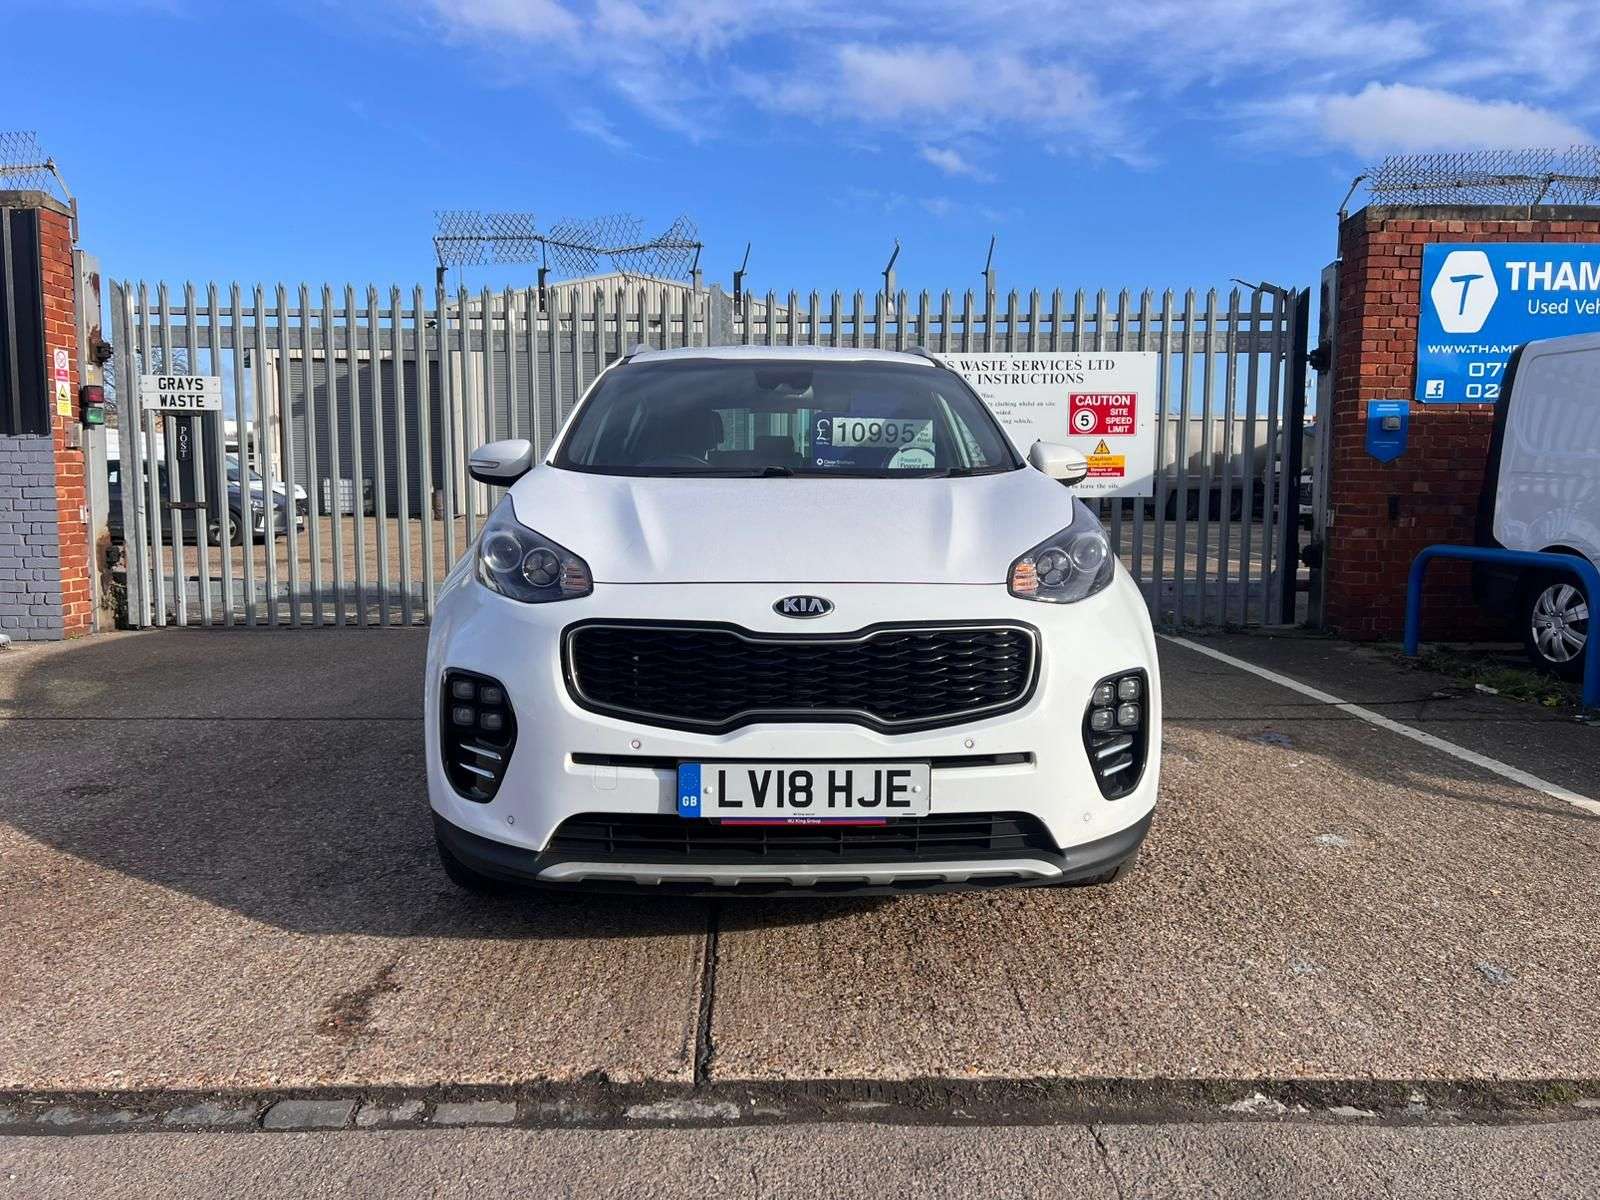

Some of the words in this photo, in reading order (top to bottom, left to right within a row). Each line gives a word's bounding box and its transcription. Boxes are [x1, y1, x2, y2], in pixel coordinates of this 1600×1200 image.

[1528, 298, 1568, 314] Used
[960, 360, 1008, 371] WASTE
[1012, 360, 1082, 371] SERVICES
[1088, 360, 1115, 371] LTD
[1469, 362, 1508, 377] 07
[158, 377, 204, 391] GRAYS
[977, 373, 1084, 385] INSTRUCTIONS
[1466, 383, 1502, 398] 02
[159, 394, 205, 408] WASTE
[1075, 395, 1131, 406] CAUTION
[1109, 408, 1129, 416] SITE
[1080, 414, 1090, 427] 5
[1105, 416, 1133, 425] SPEED
[1107, 425, 1129, 433] LIMIT
[179, 426, 188, 458] POST
[783, 598, 825, 613] KIA
[828, 770, 911, 808] HJE
[682, 796, 697, 807] GB
